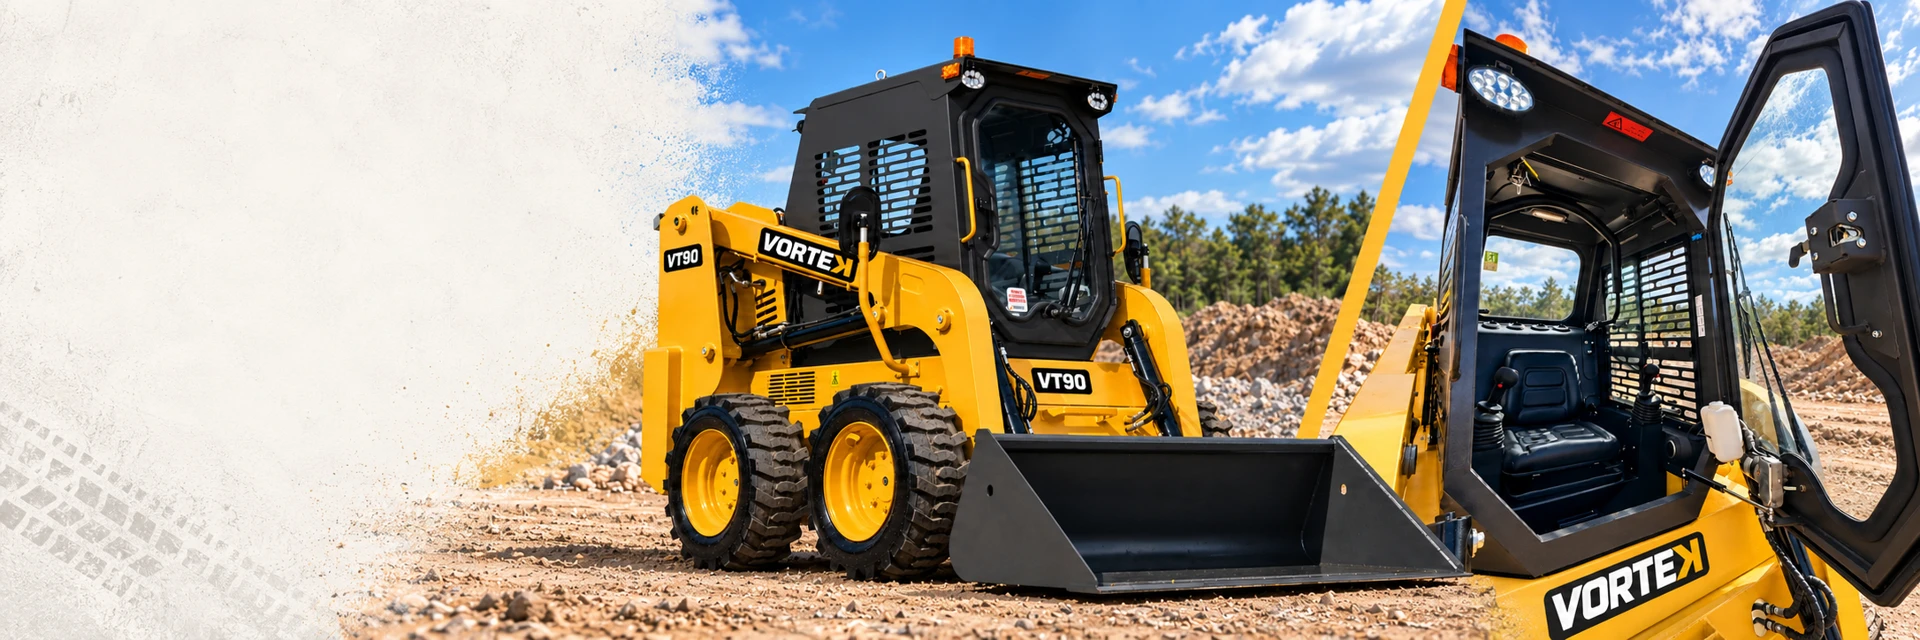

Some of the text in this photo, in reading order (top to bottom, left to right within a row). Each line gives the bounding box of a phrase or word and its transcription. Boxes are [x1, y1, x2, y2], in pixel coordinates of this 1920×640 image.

[667, 248, 699, 268] VT90
[764, 232, 853, 278] VORTEK
[1037, 372, 1087, 390] VT90
[1551, 537, 1704, 632] VORTEK
